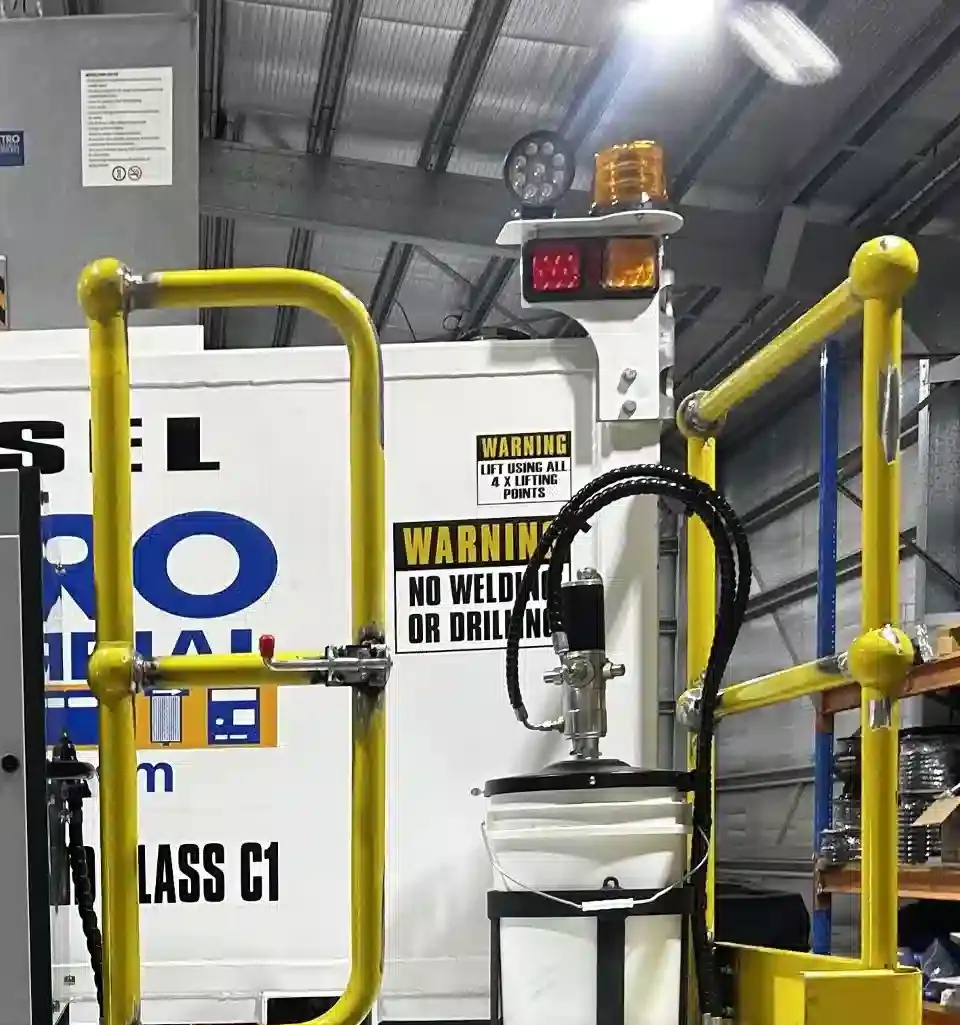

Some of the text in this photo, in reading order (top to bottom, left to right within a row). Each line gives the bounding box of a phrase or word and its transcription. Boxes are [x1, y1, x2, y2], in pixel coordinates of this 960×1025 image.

[481, 434, 567, 458] WARNING
[481, 460, 567, 475] LIFT USING ALL
[491, 474, 558, 487] 4 X LIFTING
[504, 487, 545, 499] POINTS
[403, 521, 552, 565] WARNIN
[409, 575, 441, 606] NO
[409, 612, 440, 643] OR
[137, 842, 225, 904] LASS
[240, 841, 279, 902] C1
